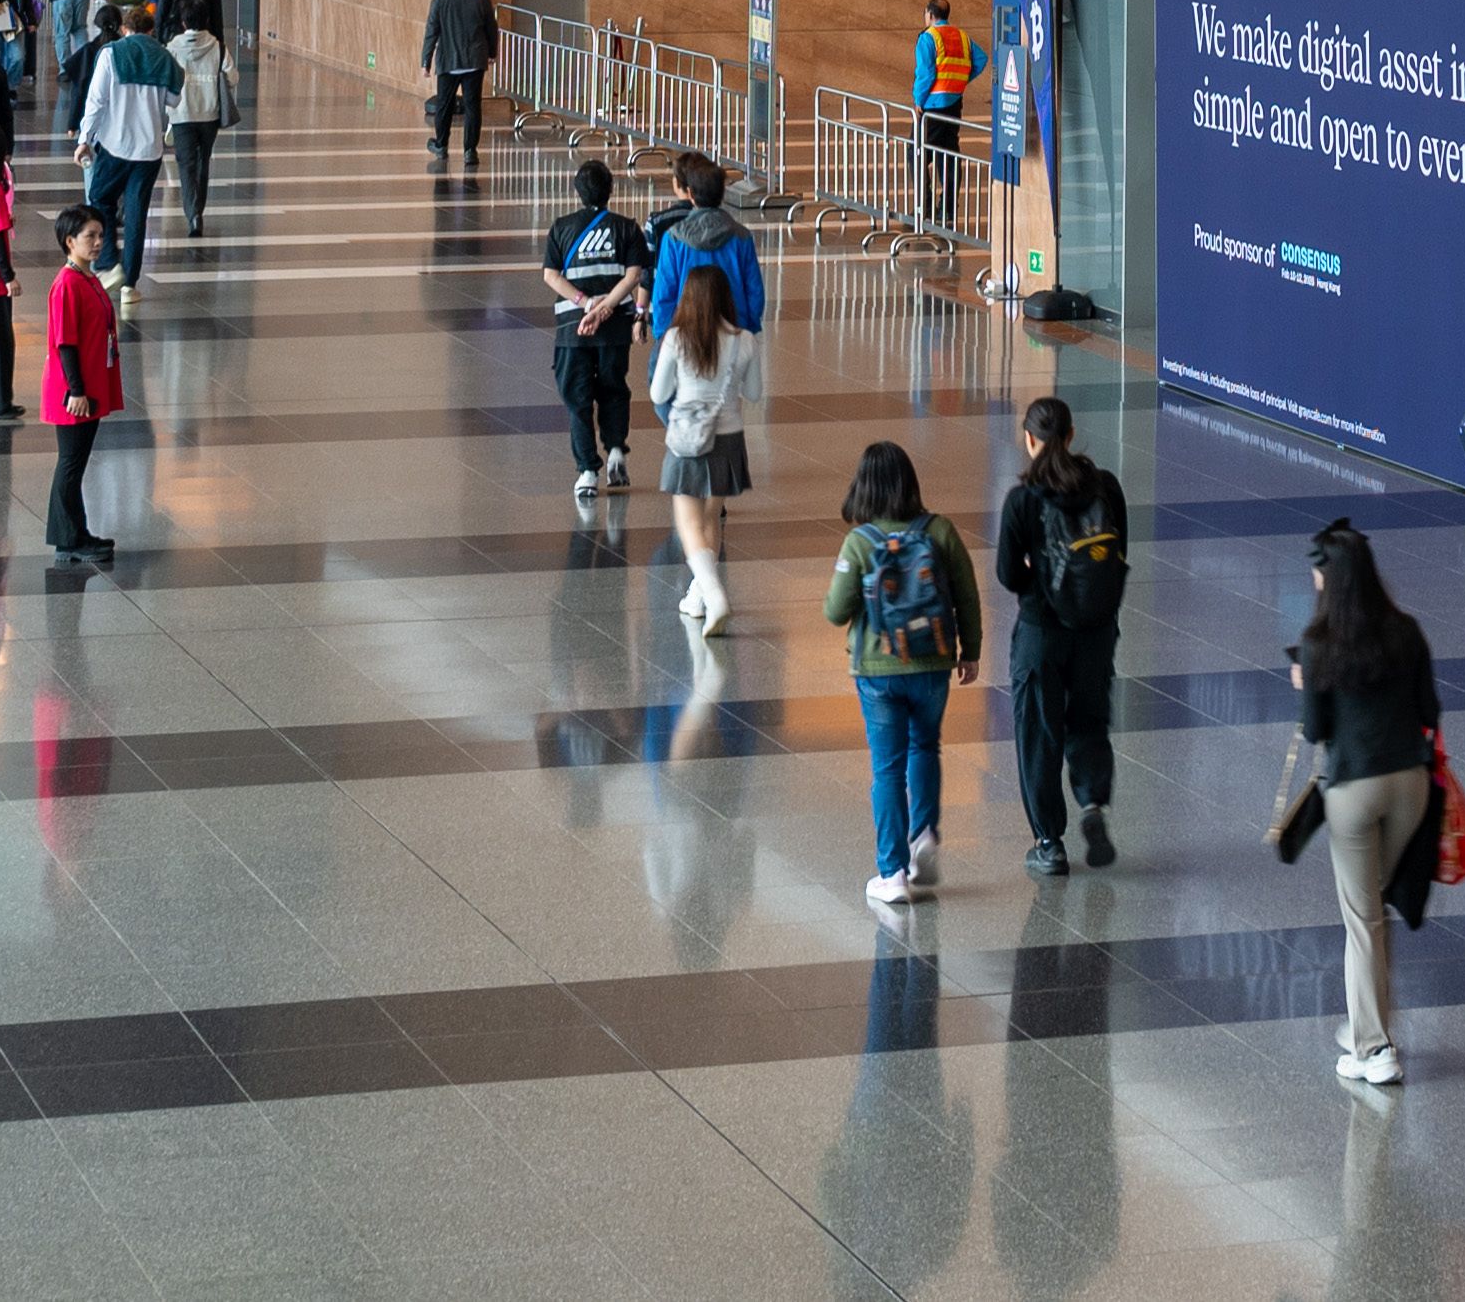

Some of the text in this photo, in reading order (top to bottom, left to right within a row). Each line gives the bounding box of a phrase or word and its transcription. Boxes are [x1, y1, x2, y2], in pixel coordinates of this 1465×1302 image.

[1192, 1, 1226, 58] We
[1232, 14, 1292, 70] make
[1298, 20, 1372, 91] digital
[1379, 48, 1443, 98] asset
[1193, 76, 1264, 148] simple
[1270, 97, 1313, 150] and
[1319, 114, 1379, 171] open
[1386, 121, 1411, 172] to
[1194, 223, 1276, 268] Proud sponsor of
[1281, 241, 1341, 276] CONSENSUS
